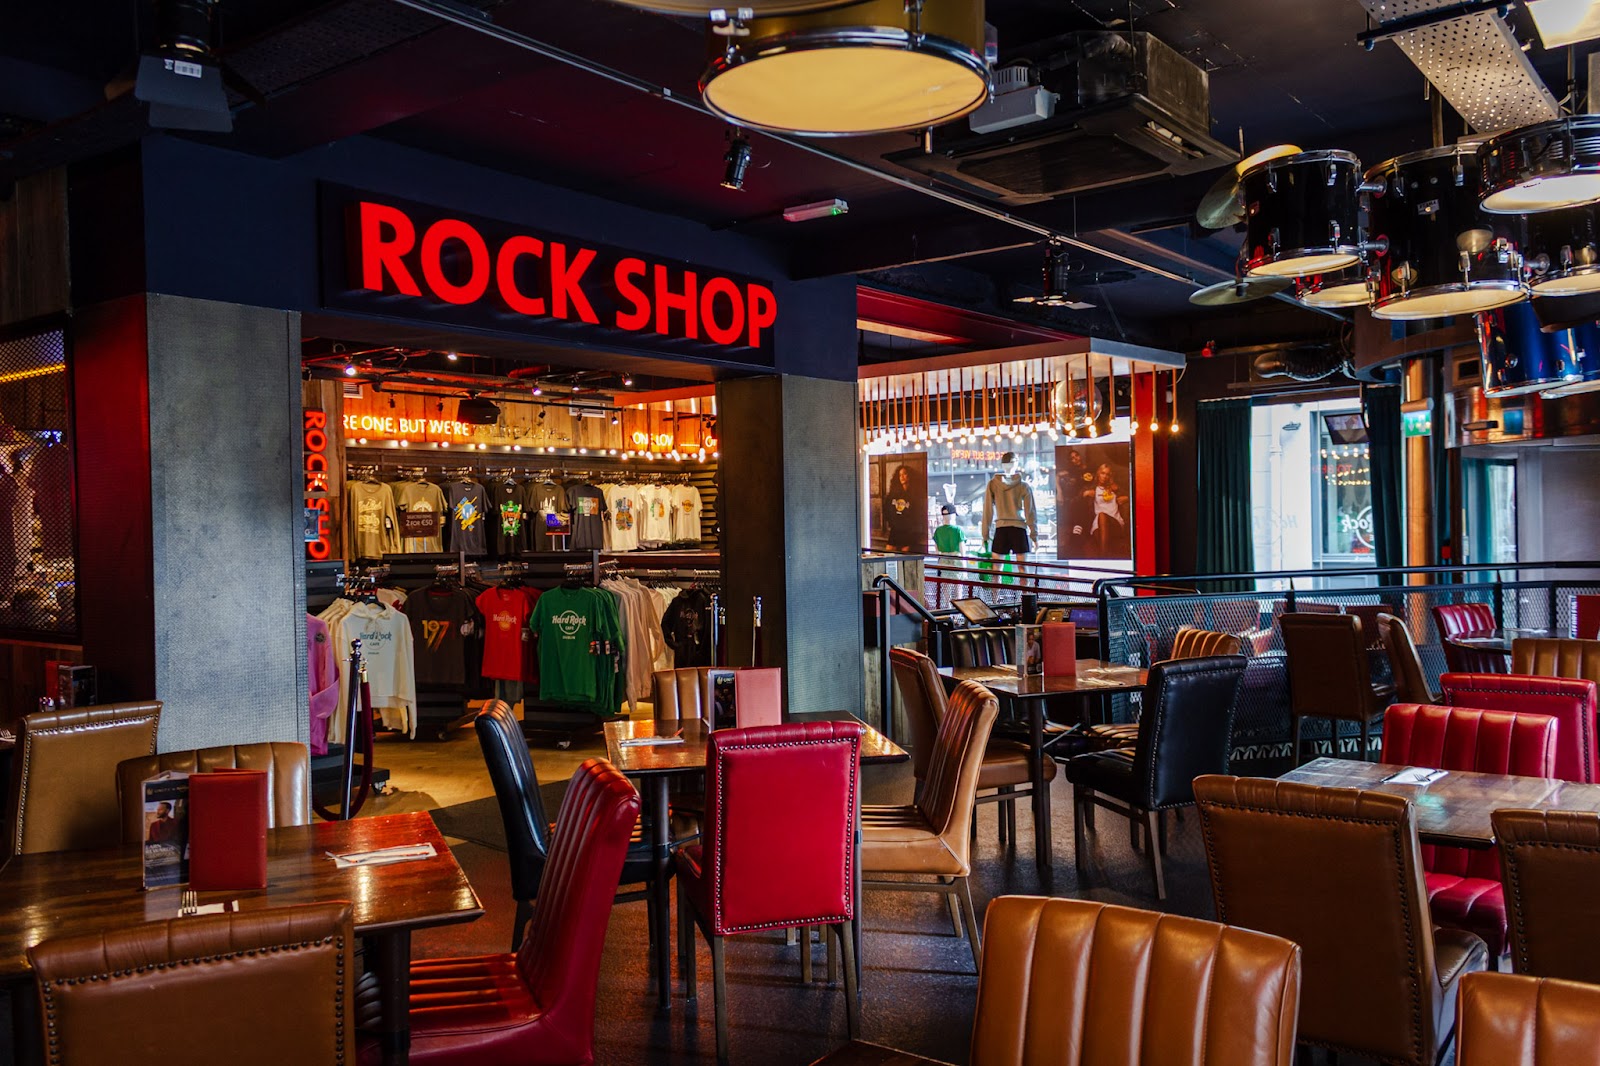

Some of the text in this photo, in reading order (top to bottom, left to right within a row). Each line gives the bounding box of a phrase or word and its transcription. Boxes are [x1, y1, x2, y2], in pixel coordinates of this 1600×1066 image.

[360, 201, 777, 348] ROCK SHOP
[361, 415, 397, 433] ONE,
[400, 418, 427, 434] BUT
[429, 419, 469, 436] WE'RE
[656, 433, 673, 446] LOV
[304, 410, 329, 492] ROCK
[552, 615, 587, 626] Hard Rock
